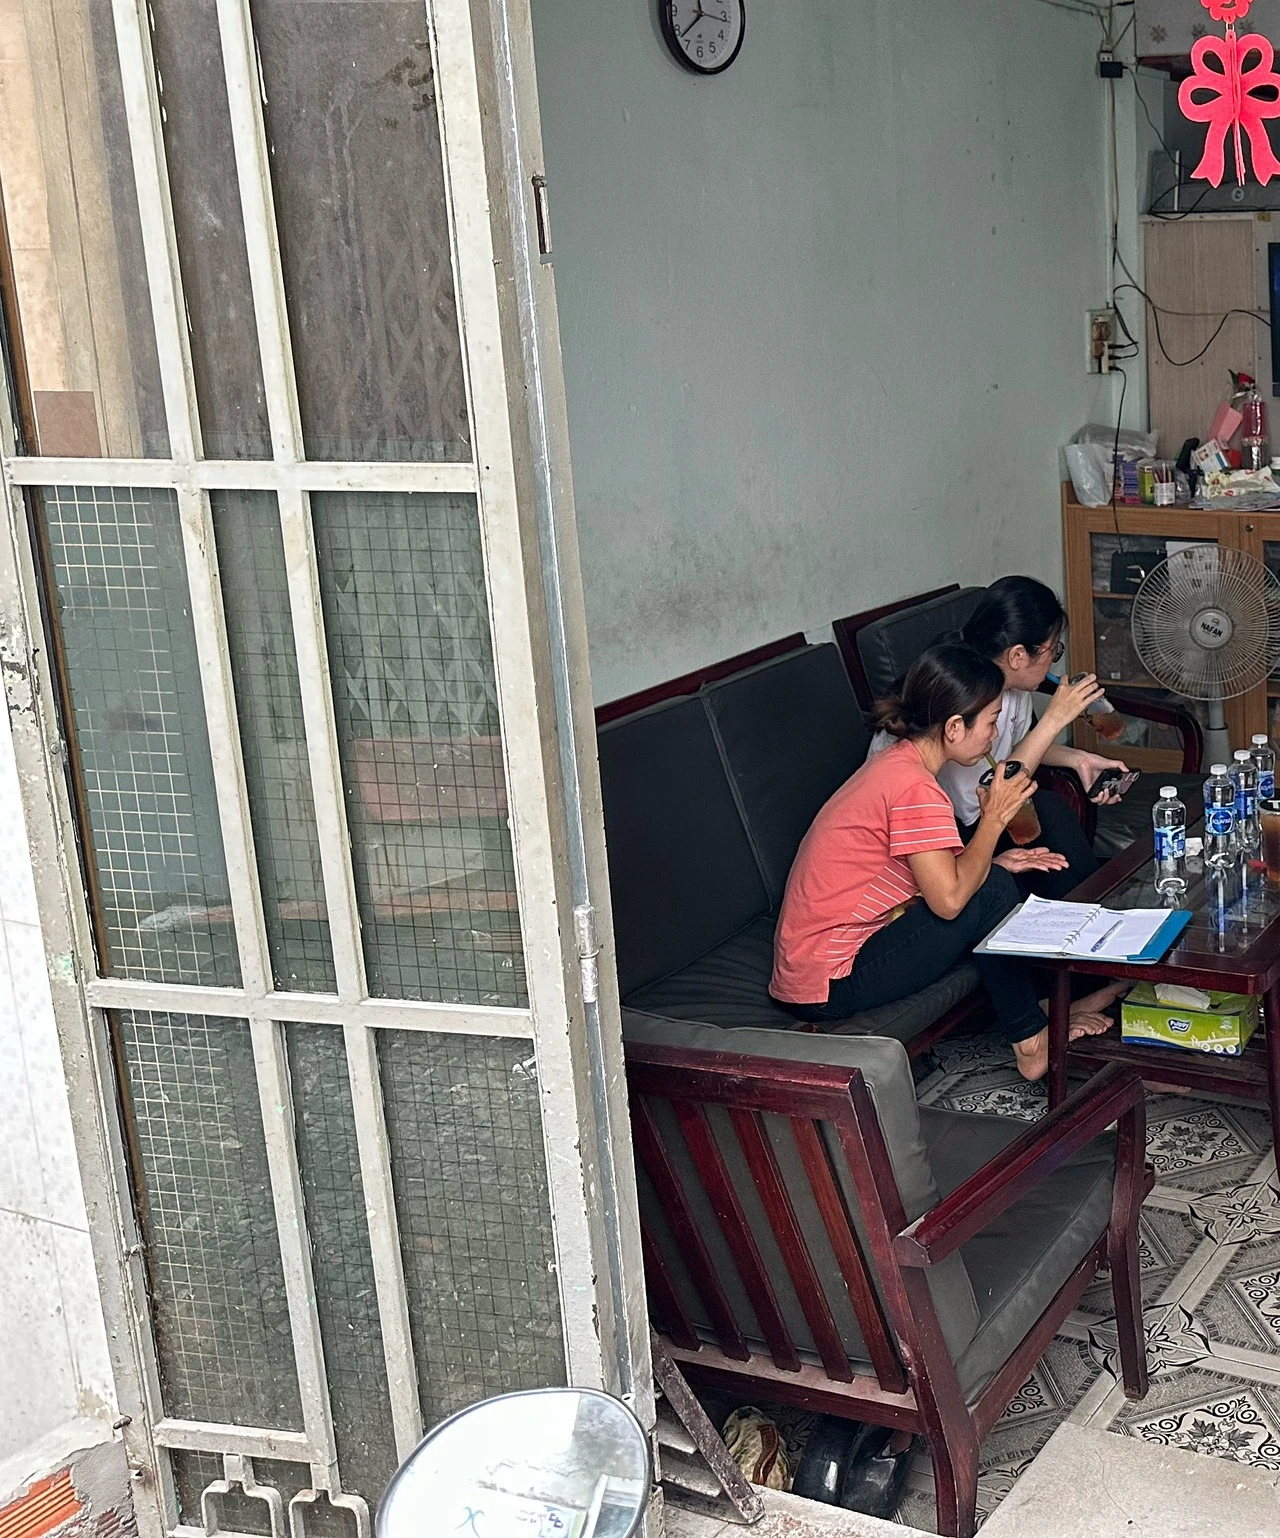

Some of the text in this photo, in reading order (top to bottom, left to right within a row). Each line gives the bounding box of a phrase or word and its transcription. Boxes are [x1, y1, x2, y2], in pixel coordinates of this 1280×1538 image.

[718, 30, 724, 41] 4
[684, 39, 691, 51] 7
[709, 41, 716, 54] 5
[697, 46, 704, 58] 6
